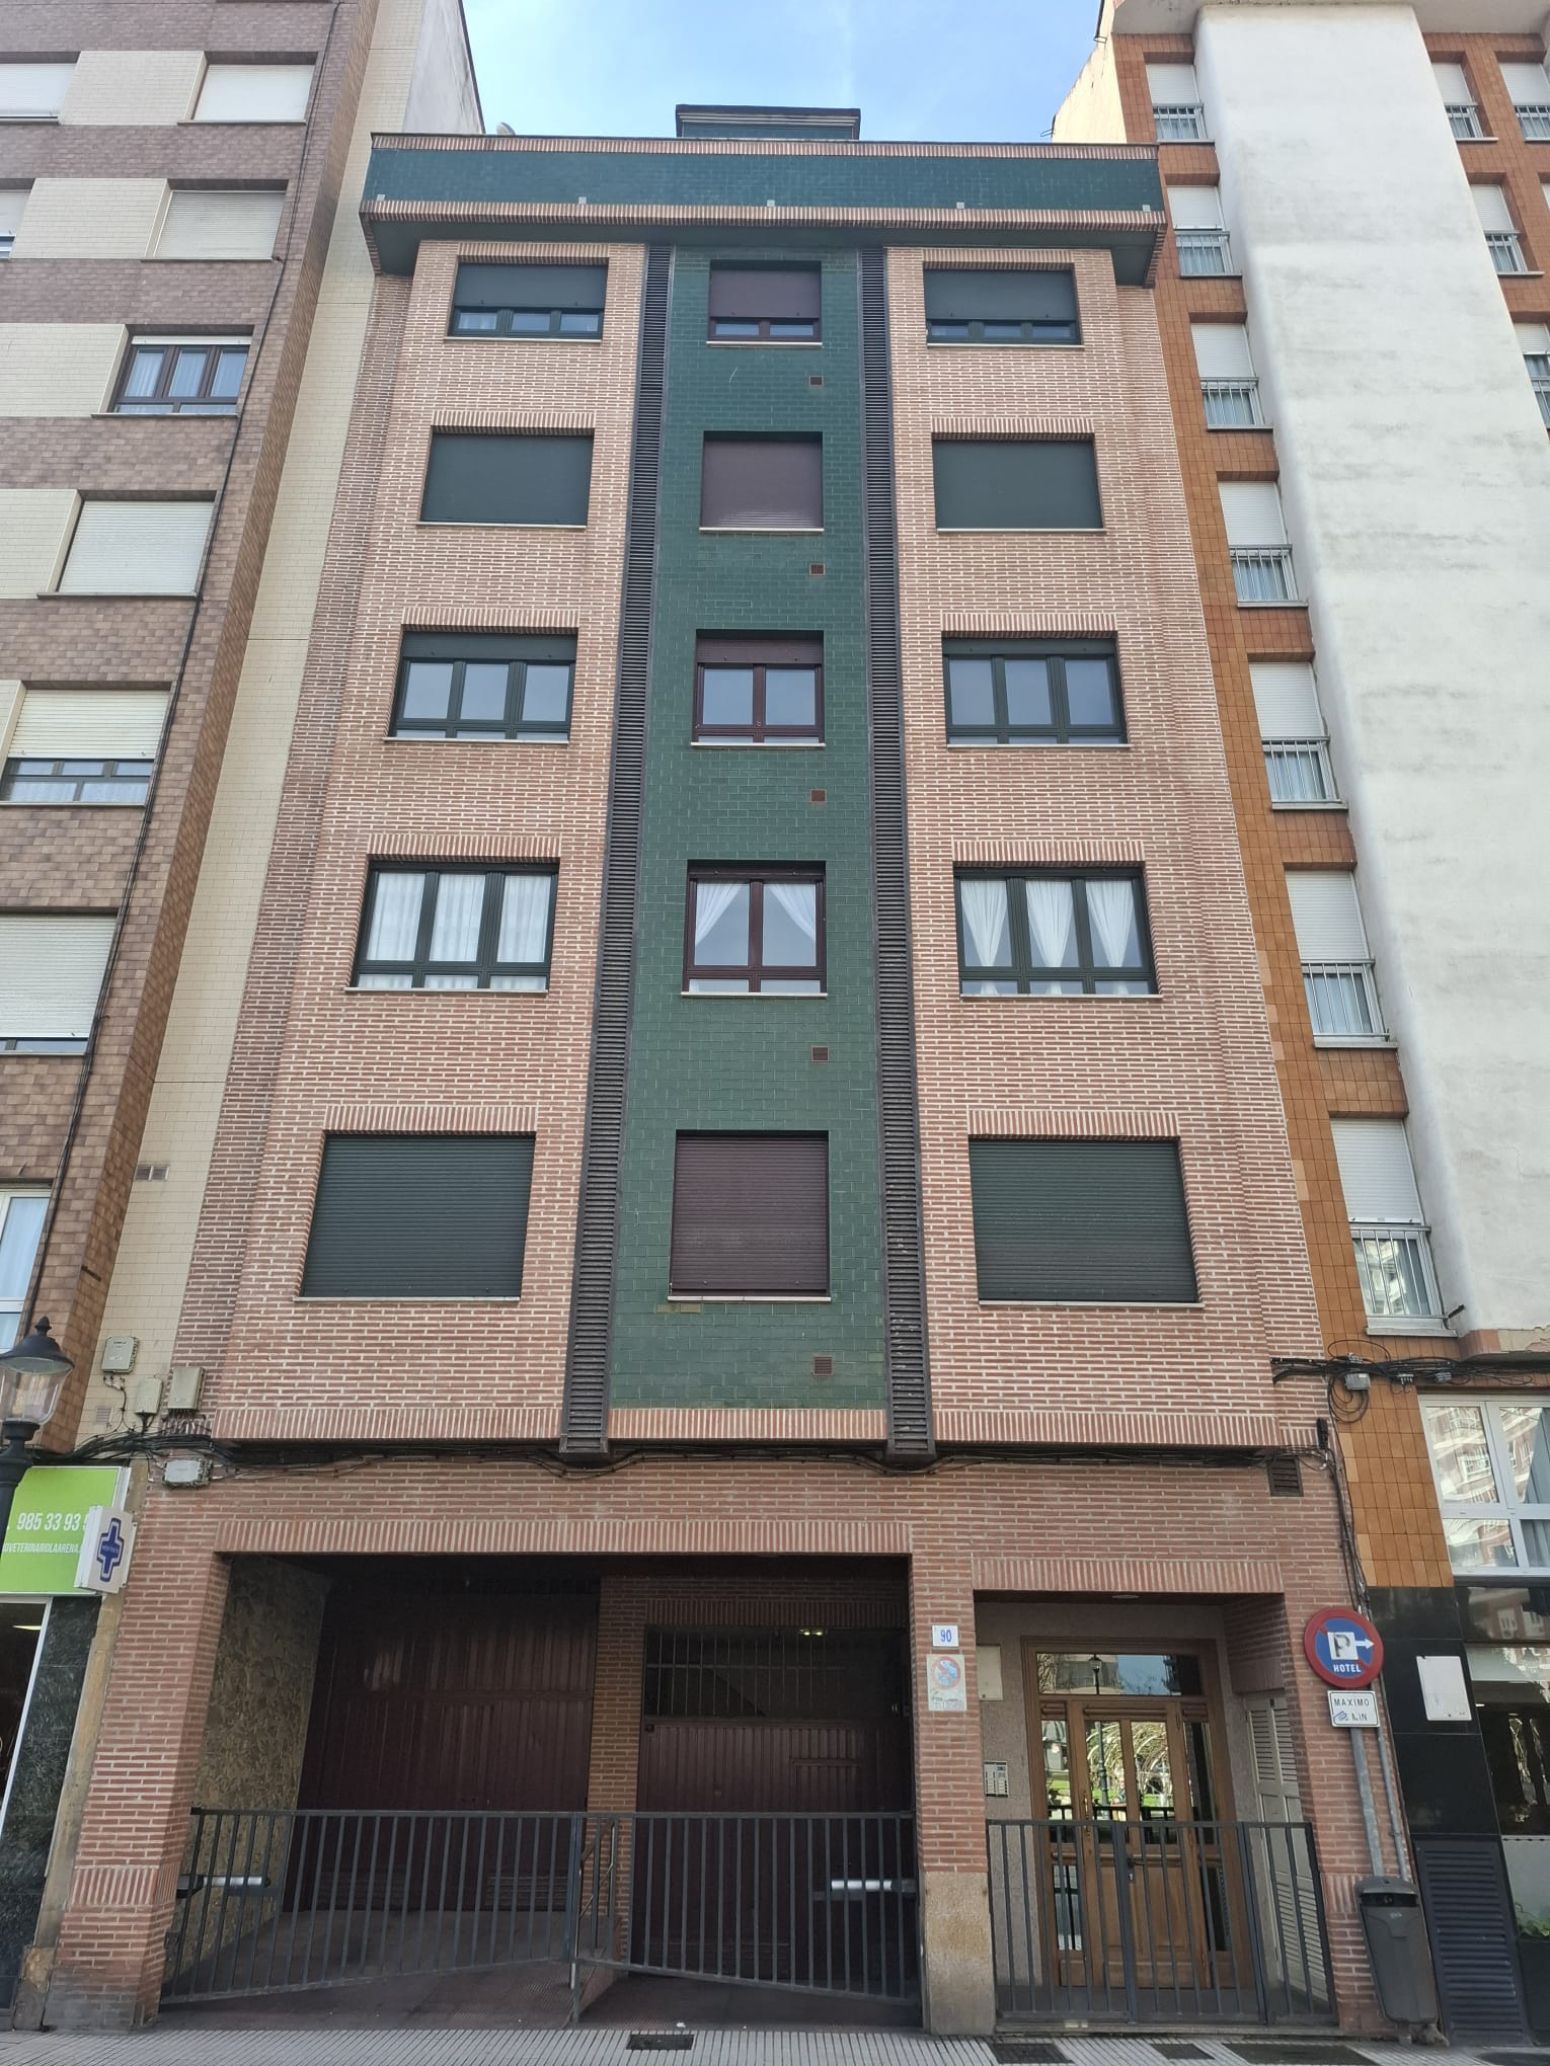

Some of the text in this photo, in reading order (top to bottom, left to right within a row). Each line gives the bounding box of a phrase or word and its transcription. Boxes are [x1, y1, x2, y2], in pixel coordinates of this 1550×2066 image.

[17, 1512, 43, 1531] 985
[44, 1513, 63, 1531] 33
[63, 1513, 82, 1532] 93
[940, 1629, 952, 1643] 90
[1333, 1633, 1351, 1658] P
[1333, 1663, 1362, 1673] HOTEL
[1333, 1697, 1371, 1707] MAXIMO
